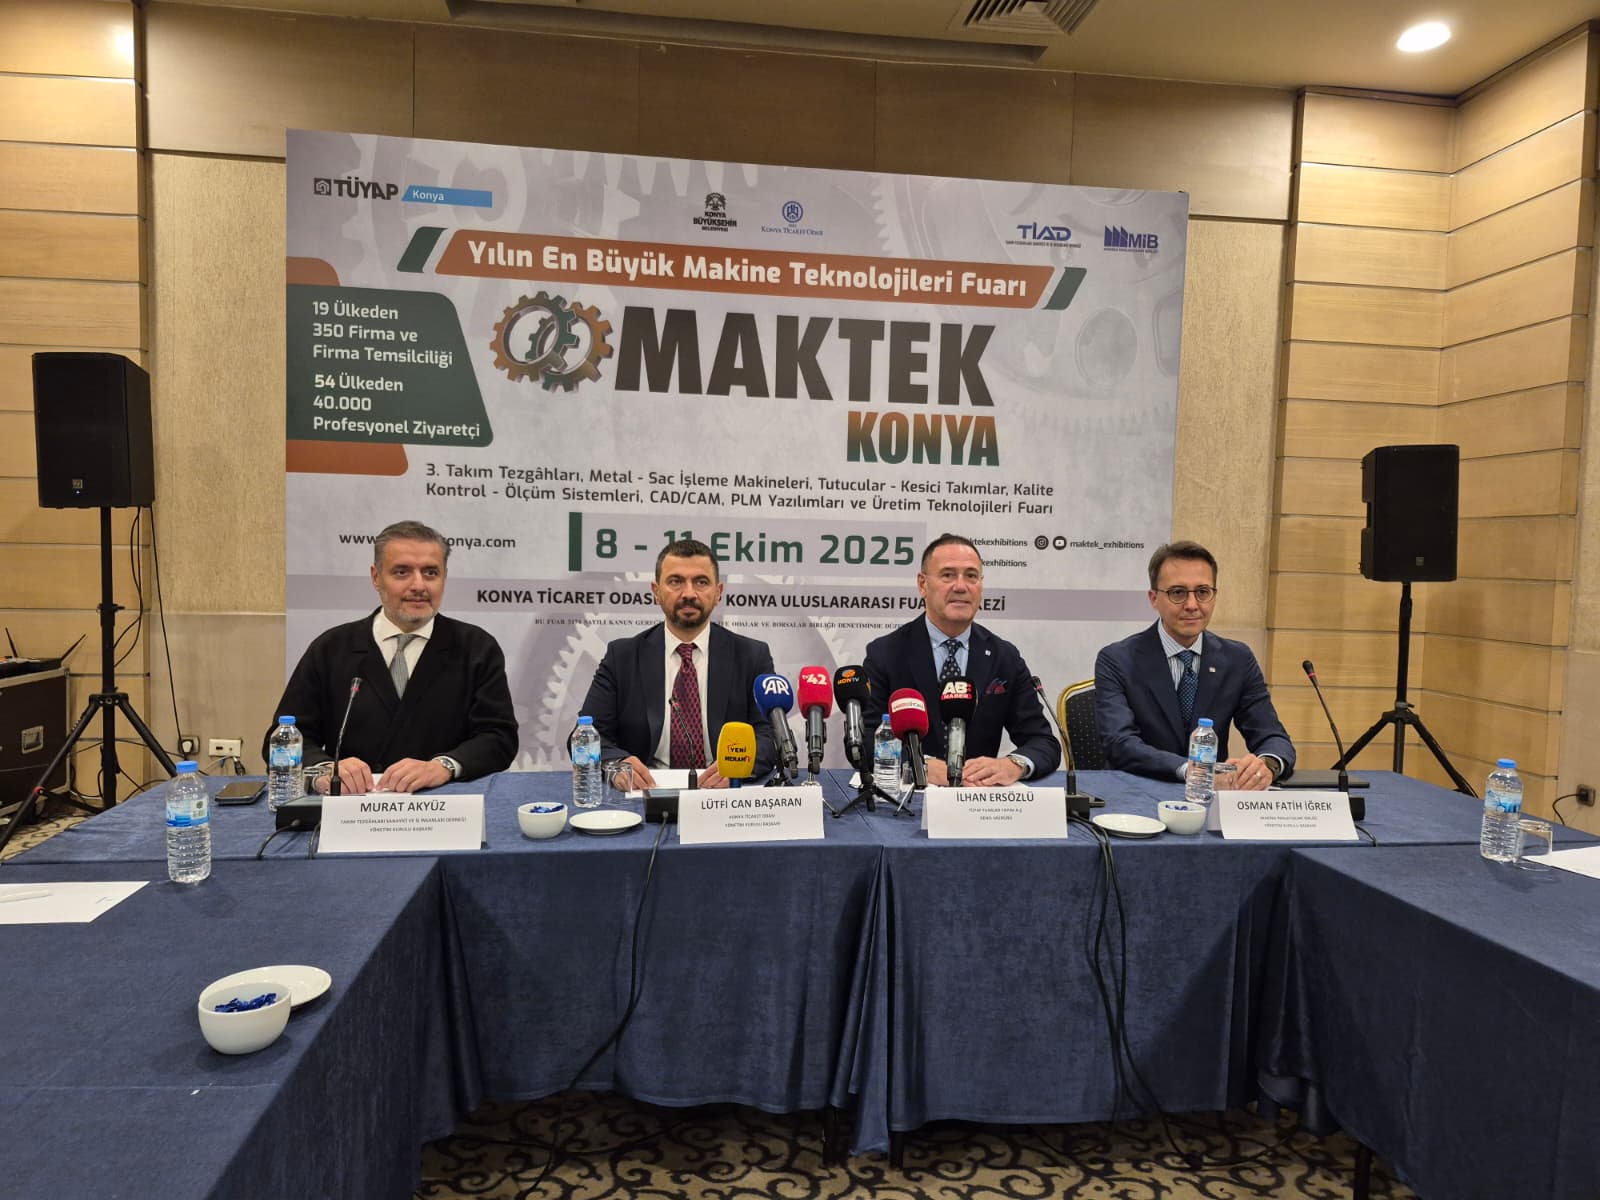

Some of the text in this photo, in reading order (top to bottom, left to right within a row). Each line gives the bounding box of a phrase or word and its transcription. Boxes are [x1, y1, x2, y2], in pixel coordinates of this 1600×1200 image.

[333, 176, 399, 201] TÜYAP
[412, 189, 445, 202] Konya
[468, 240, 1027, 297] Yılın En Büyük Makine Teknolojileri Fuarı
[313, 299, 399, 320] 19 Ülkeden
[313, 323, 418, 342] 350 Firma ve
[313, 344, 454, 368] Firma Temsilciliği
[614, 305, 996, 407] MAKTEK
[314, 371, 404, 392] 54 Ülkeden
[313, 396, 372, 412] 40.000
[313, 416, 481, 440] Profesyonel Ziyaretçi
[846, 410, 1000, 467] KONYA
[426, 463, 440, 477] 3.
[446, 464, 493, 479] Takım
[499, 465, 584, 485] Tezgâhları,
[589, 469, 633, 484] Metal
[649, 471, 675, 485] Sac
[680, 469, 729, 490] İşleme
[733, 474, 813, 491] Makineleri,
[818, 477, 887, 493] Tutucular
[901, 480, 941, 494] Kesici
[946, 481, 1009, 497] Takımlar,
[1014, 482, 1054, 497] Kalite
[426, 483, 486, 498] Kontrol
[505, 484, 556, 503] Ölçüm
[562, 487, 644, 505] Sistemleri,
[650, 489, 725, 507] CAD/CAM,
[731, 493, 763, 508] PLM
[769, 494, 845, 510] Yazılımları
[850, 499, 867, 510] ve
[872, 495, 921, 511] Üretim
[928, 498, 1012, 516] Teknolojileri
[1017, 501, 1053, 515] Fuarı
[595, 528, 618, 560] 8
[710, 531, 803, 563] Ekim
[818, 533, 915, 566] 2025
[1069, 539, 1145, 549] maktek_exhibitions
[476, 589, 533, 604] KONYA
[537, 586, 606, 605] TİCARET
[726, 593, 778, 608] KONYA
[781, 594, 895, 609] ULUSLARARASI
[899, 597, 926, 610] FUA
[360, 799, 446, 813] MURAT AKYÜZ
[701, 797, 802, 810] LÜTFİ CAN BAŞARAN
[956, 790, 1034, 802] İLHAN ERSÖZLÜ
[1237, 799, 1332, 811] OSMAN FATİH İĞREK
